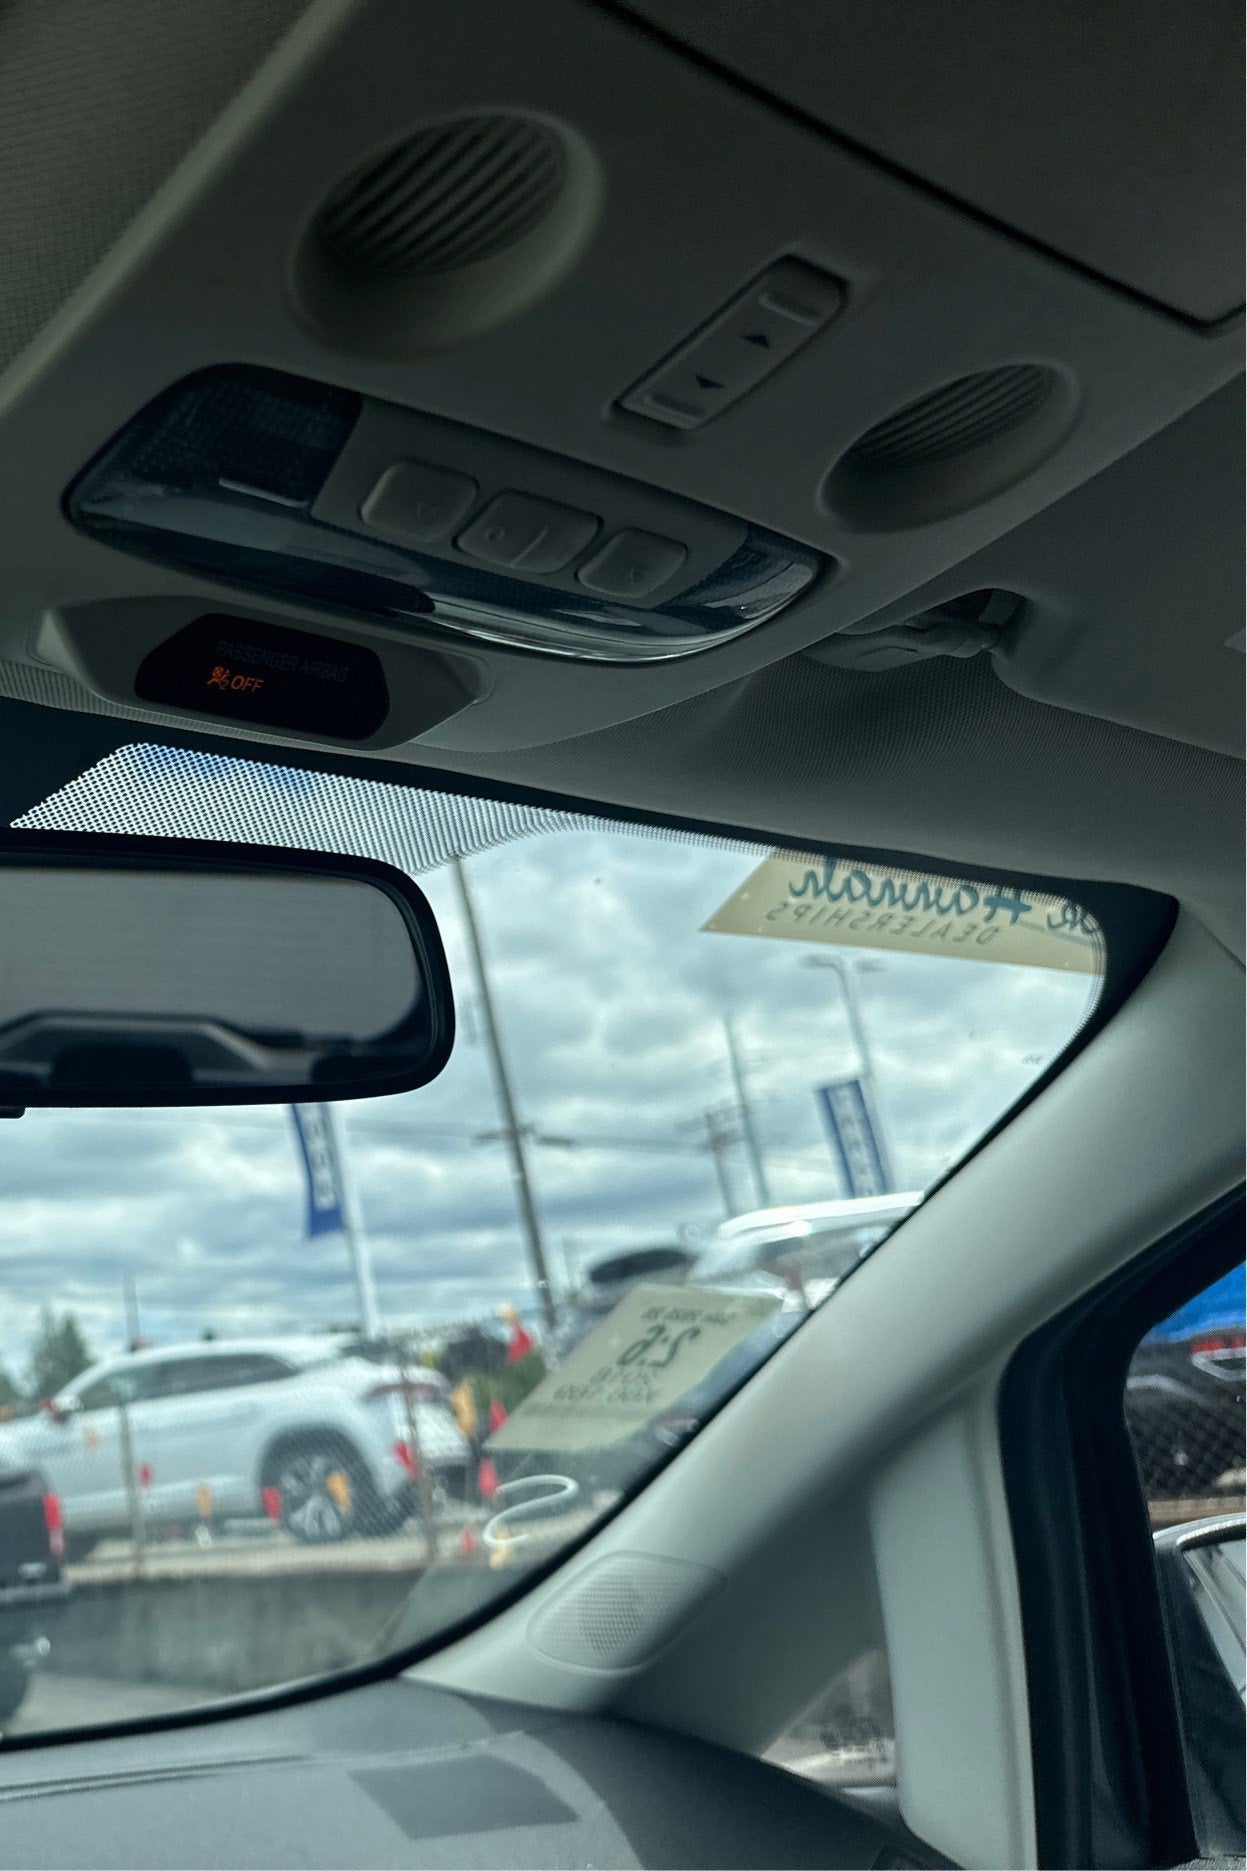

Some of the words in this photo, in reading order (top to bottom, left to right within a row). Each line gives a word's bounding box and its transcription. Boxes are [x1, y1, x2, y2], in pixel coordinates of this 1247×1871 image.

[215, 640, 299, 672] PASSENGER
[298, 656, 350, 683] AIRBAG
[230, 674, 265, 693] OFF
